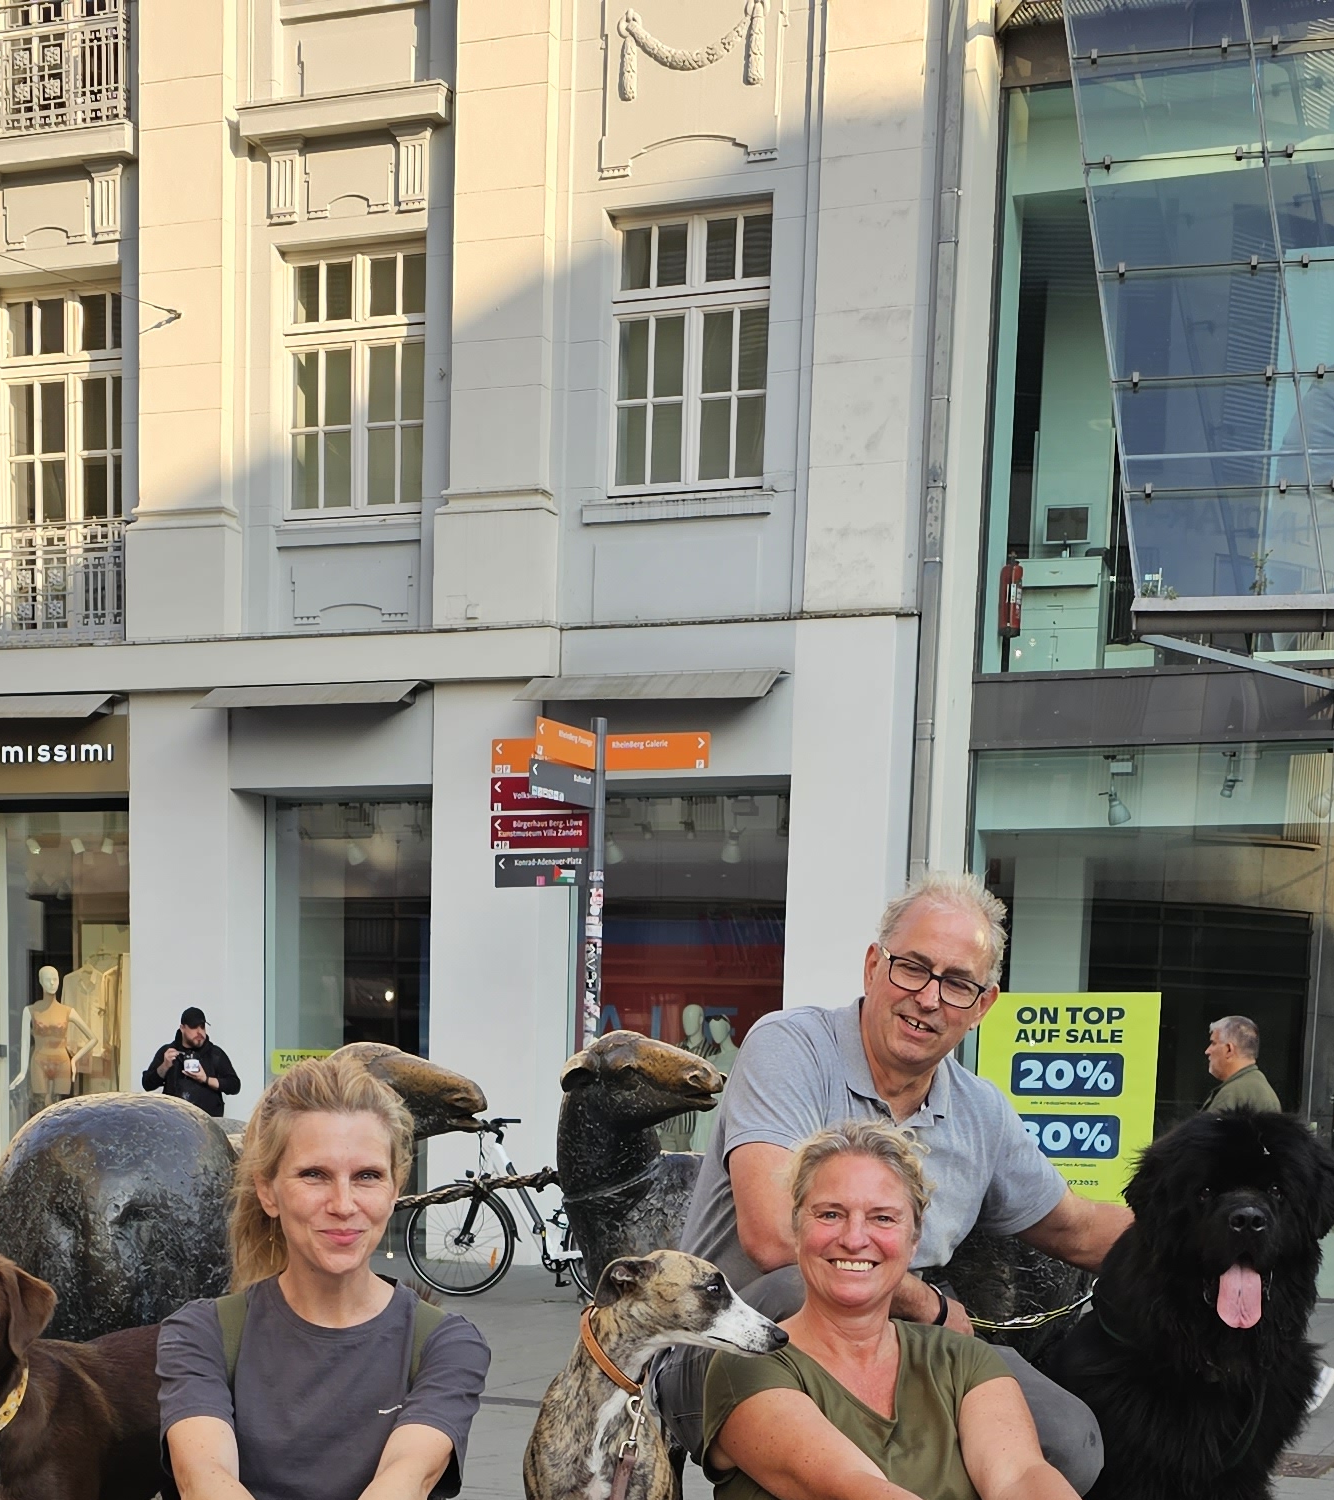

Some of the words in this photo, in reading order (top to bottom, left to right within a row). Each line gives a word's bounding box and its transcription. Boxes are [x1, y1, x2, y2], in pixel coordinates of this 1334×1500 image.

[645, 739, 668, 748] Galerie
[543, 829, 557, 837] Villa
[557, 828, 583, 837] Zanders
[1016, 1006, 1059, 1025] ON
[1065, 1006, 1126, 1025] TOP
[1014, 1028, 1060, 1044] AUF
[1065, 1028, 1124, 1044] SALE
